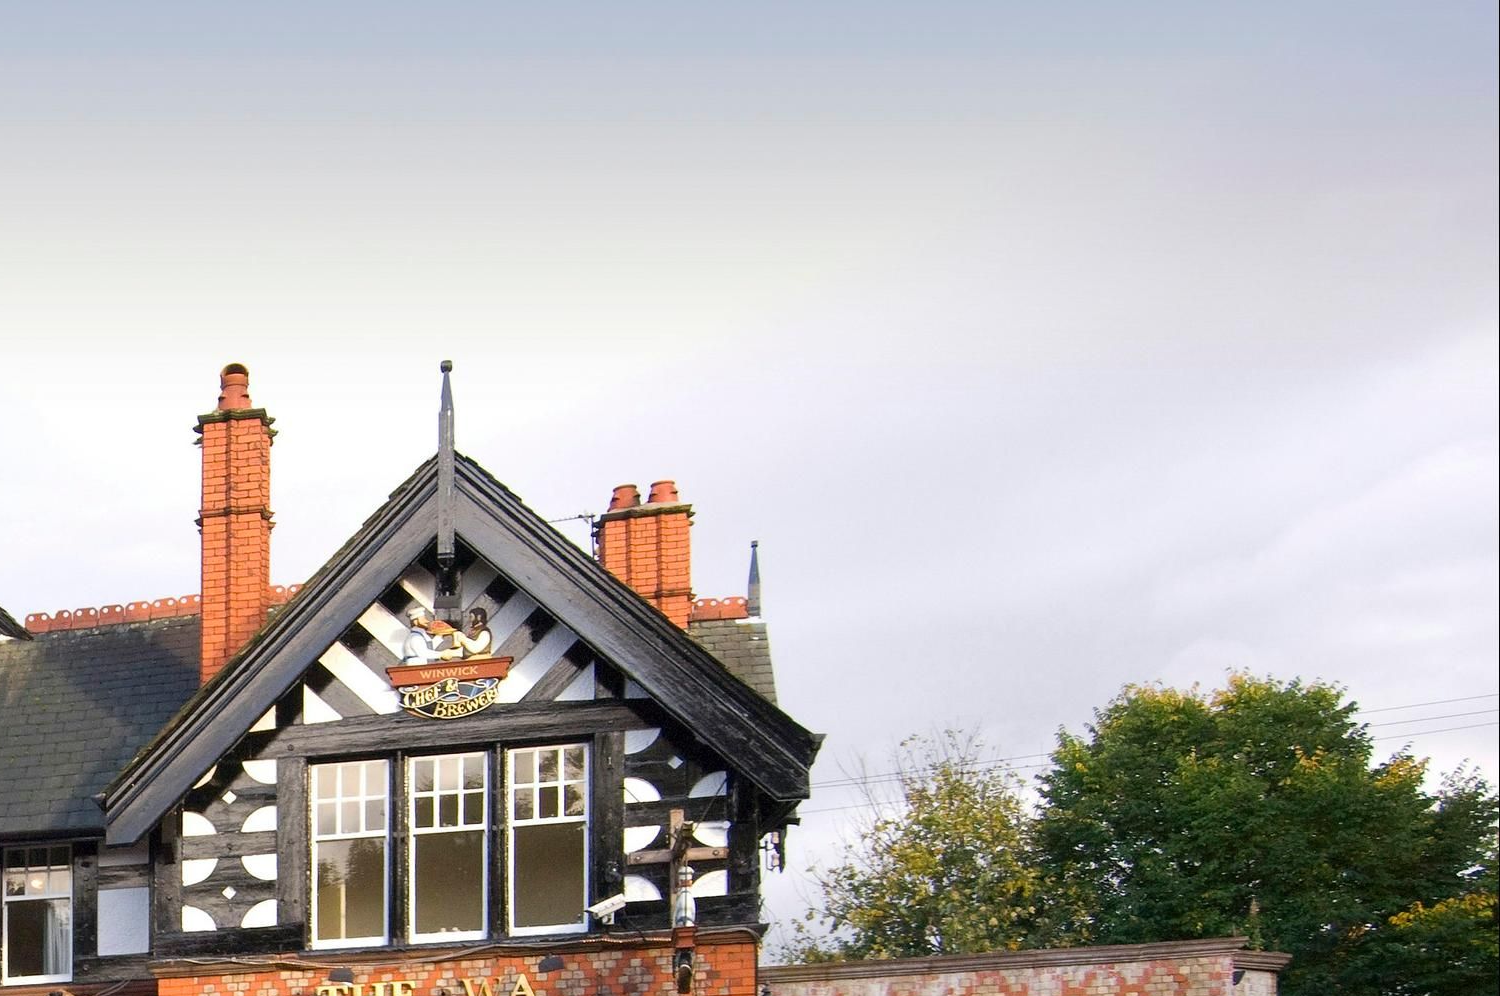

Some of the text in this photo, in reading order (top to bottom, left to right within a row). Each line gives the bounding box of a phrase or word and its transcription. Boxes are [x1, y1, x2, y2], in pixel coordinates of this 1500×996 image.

[419, 665, 479, 679] WINWICK
[403, 679, 459, 708] CHEF &
[433, 688, 498, 717] BREWER
